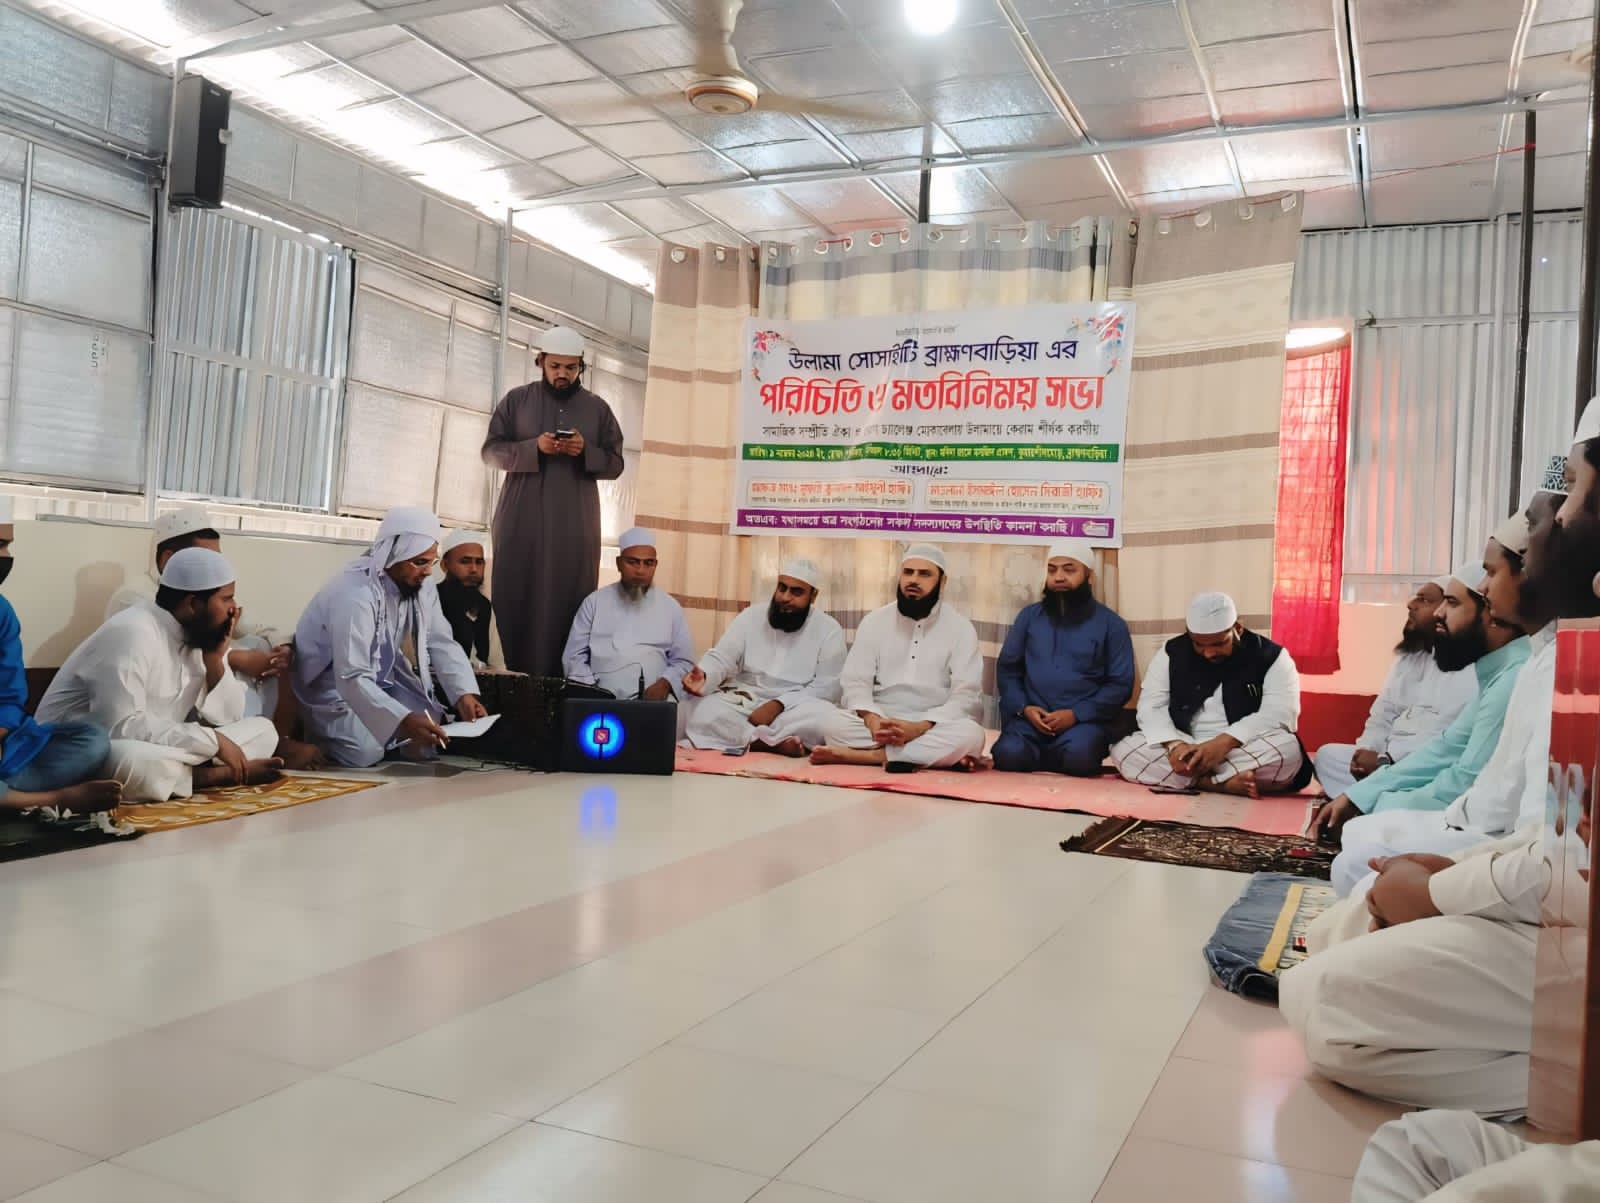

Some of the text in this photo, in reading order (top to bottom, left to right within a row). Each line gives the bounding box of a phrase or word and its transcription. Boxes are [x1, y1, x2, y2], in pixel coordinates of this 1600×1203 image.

[788, 335, 1079, 371] উলামা সোসাইটি ব্রাহ্মণবাড়িয়া এর
[760, 376, 865, 416] পরিচিতি
[891, 370, 1040, 412] মতবিনিময়
[1045, 376, 1105, 411] সভা
